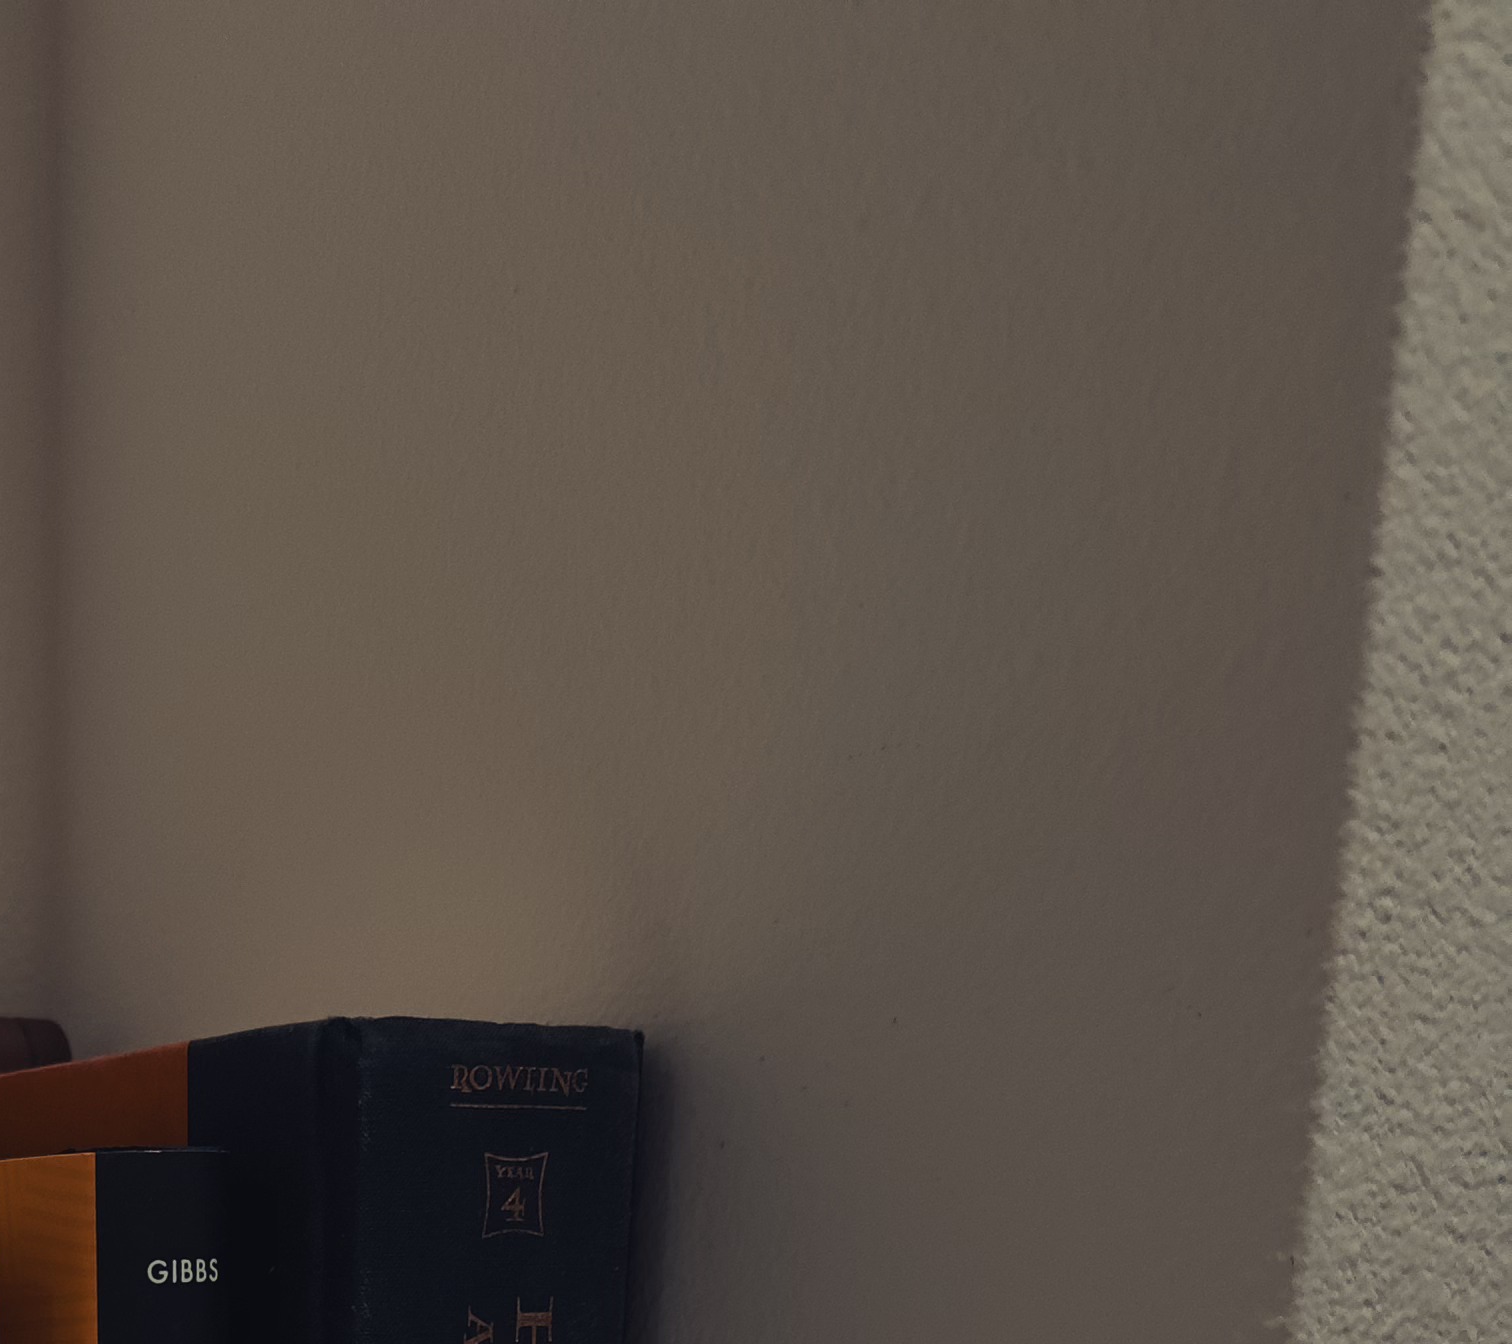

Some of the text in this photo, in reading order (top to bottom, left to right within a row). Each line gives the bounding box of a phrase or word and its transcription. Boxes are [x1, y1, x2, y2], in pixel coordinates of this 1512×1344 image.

[450, 1064, 588, 1096] ROWLING
[496, 1165, 535, 1179] YEAR
[501, 1187, 525, 1222] 4
[147, 1258, 218, 1284] GIBBS
